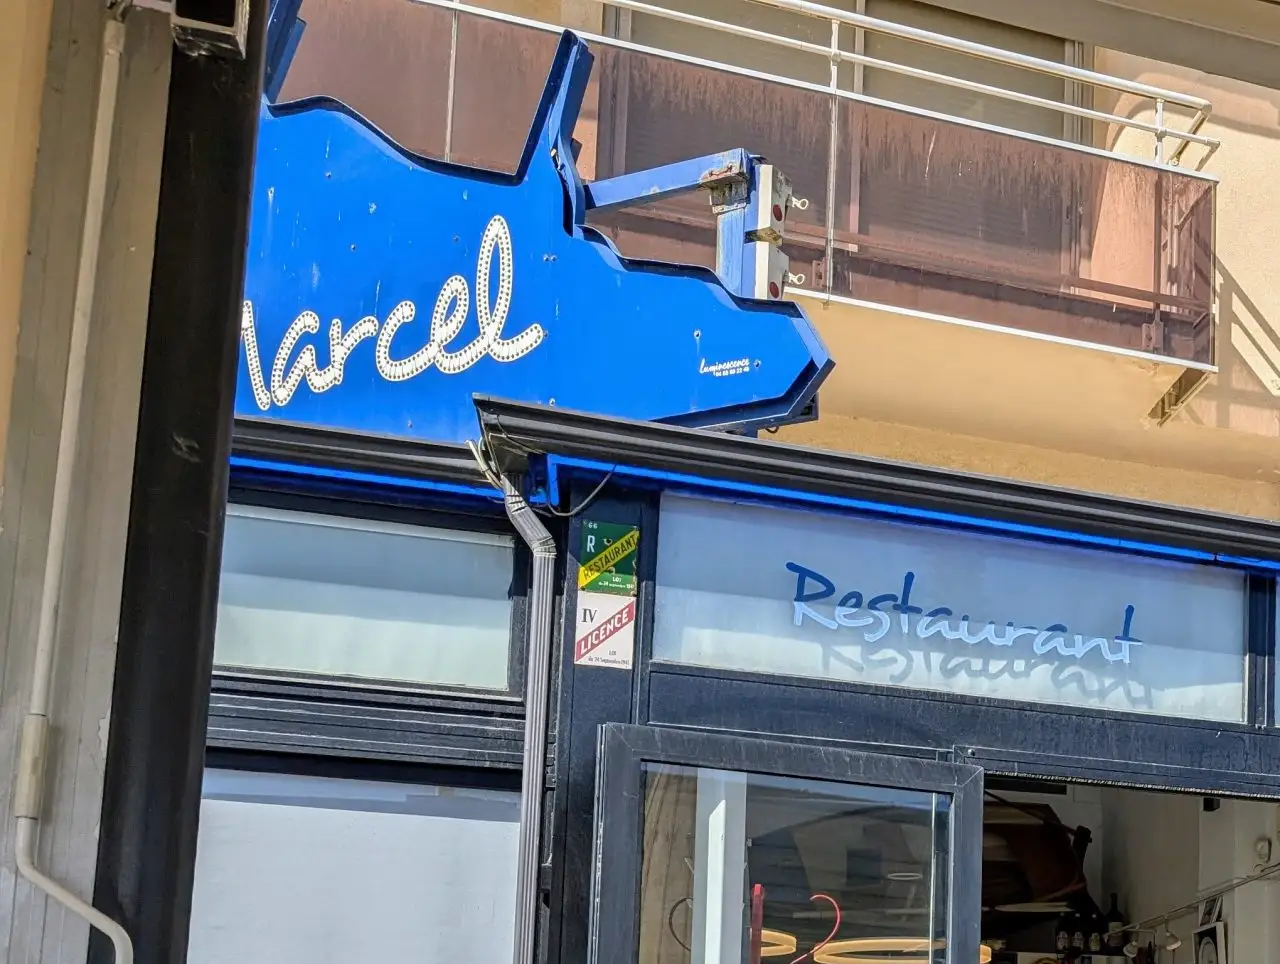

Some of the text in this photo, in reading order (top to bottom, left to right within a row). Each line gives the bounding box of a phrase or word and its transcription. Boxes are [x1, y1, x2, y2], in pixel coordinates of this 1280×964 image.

[583, 534, 637, 580] RESTAURANT
[586, 535, 596, 553] R
[580, 607, 599, 624] IV
[580, 607, 630, 655] LICENCE
[786, 561, 1142, 663] Restaurant
